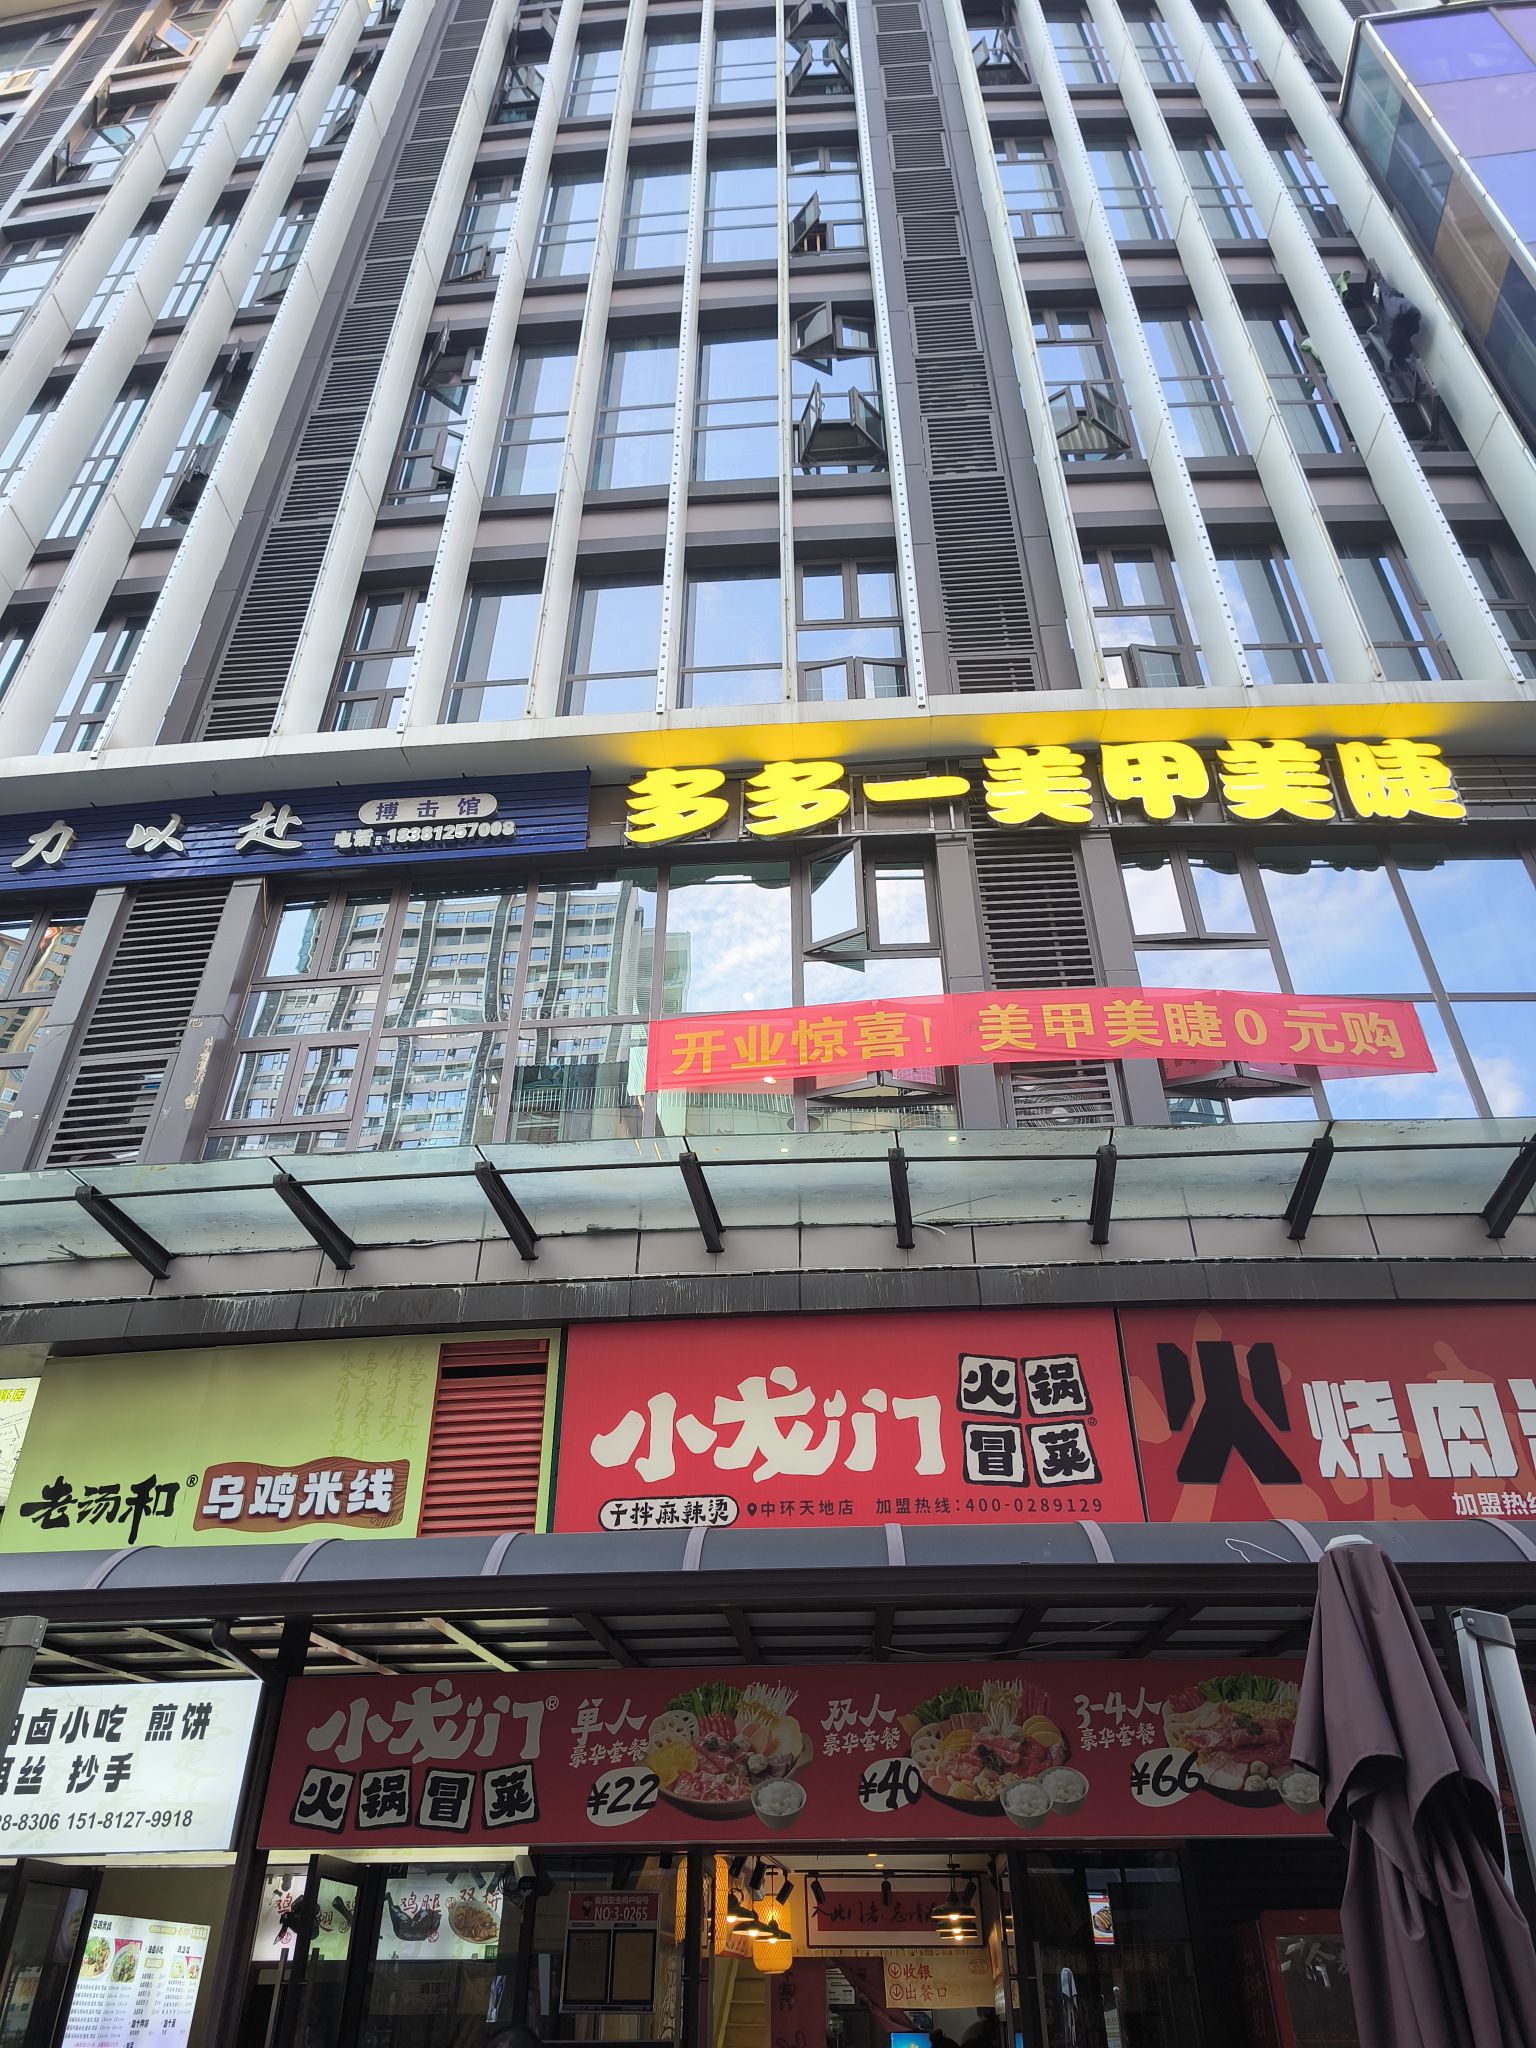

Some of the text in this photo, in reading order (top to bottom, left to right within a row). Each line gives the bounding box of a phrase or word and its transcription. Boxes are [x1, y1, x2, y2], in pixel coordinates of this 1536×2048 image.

[376, 797, 480, 821] 搏击馆
[963, 1363, 1086, 1406] 火锅
[590, 1366, 946, 1483] 小龙门
[970, 1428, 1091, 1477] 冒菜
[20, 1468, 395, 1544] 老汤和 乌鸡米线
[760, 1500, 853, 1517] 中环天地店
[145, 1702, 212, 1741] 煎饼
[307, 1679, 544, 1763] 小龙门
[571, 1698, 647, 1746] 单人
[821, 1693, 897, 1732] 双人
[1075, 1687, 1163, 1730] 3-4人
[568, 1738, 650, 1768] 豪华套餐
[822, 1727, 901, 1757] 豪华套餐
[1079, 1721, 1156, 1750] 豪华套餐
[66, 1752, 133, 1794] 抄手
[859, 1760, 924, 1809] ¥40
[1130, 1753, 1203, 1797] ¥66
[297, 1770, 535, 1824] 火锅冒菜
[587, 1773, 659, 1816] ¥22
[68, 1810, 193, 1831] 151-8127-9918
[595, 1906, 648, 1921] NO:3-0265
[903, 1963, 933, 1980] 收银
[904, 1984, 948, 2001] 出餐口
